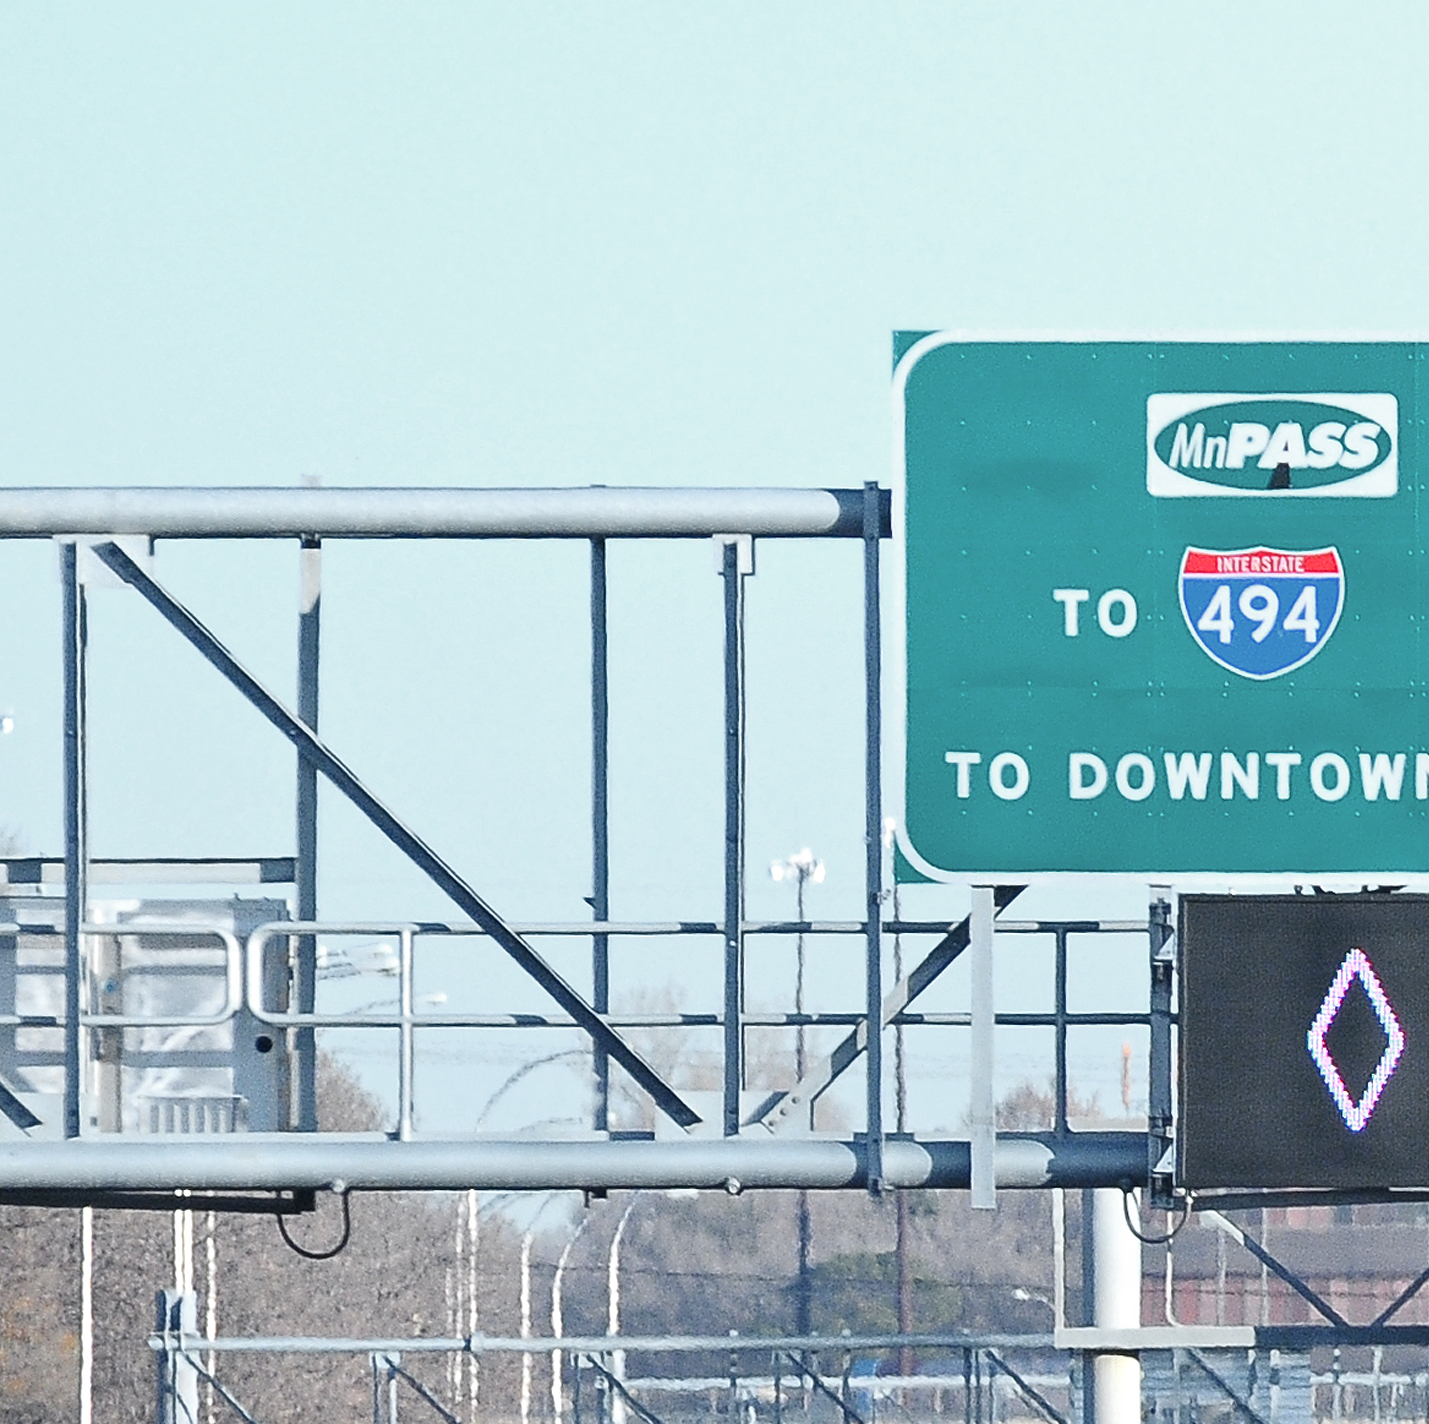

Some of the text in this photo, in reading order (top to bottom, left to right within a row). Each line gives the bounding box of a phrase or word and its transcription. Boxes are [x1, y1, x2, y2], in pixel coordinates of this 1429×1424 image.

[1168, 421, 1381, 469] MnPASS
[1217, 556, 1304, 573] INTERSTATE
[1054, 584, 1320, 643] TO 494
[945, 751, 1030, 800] TO
